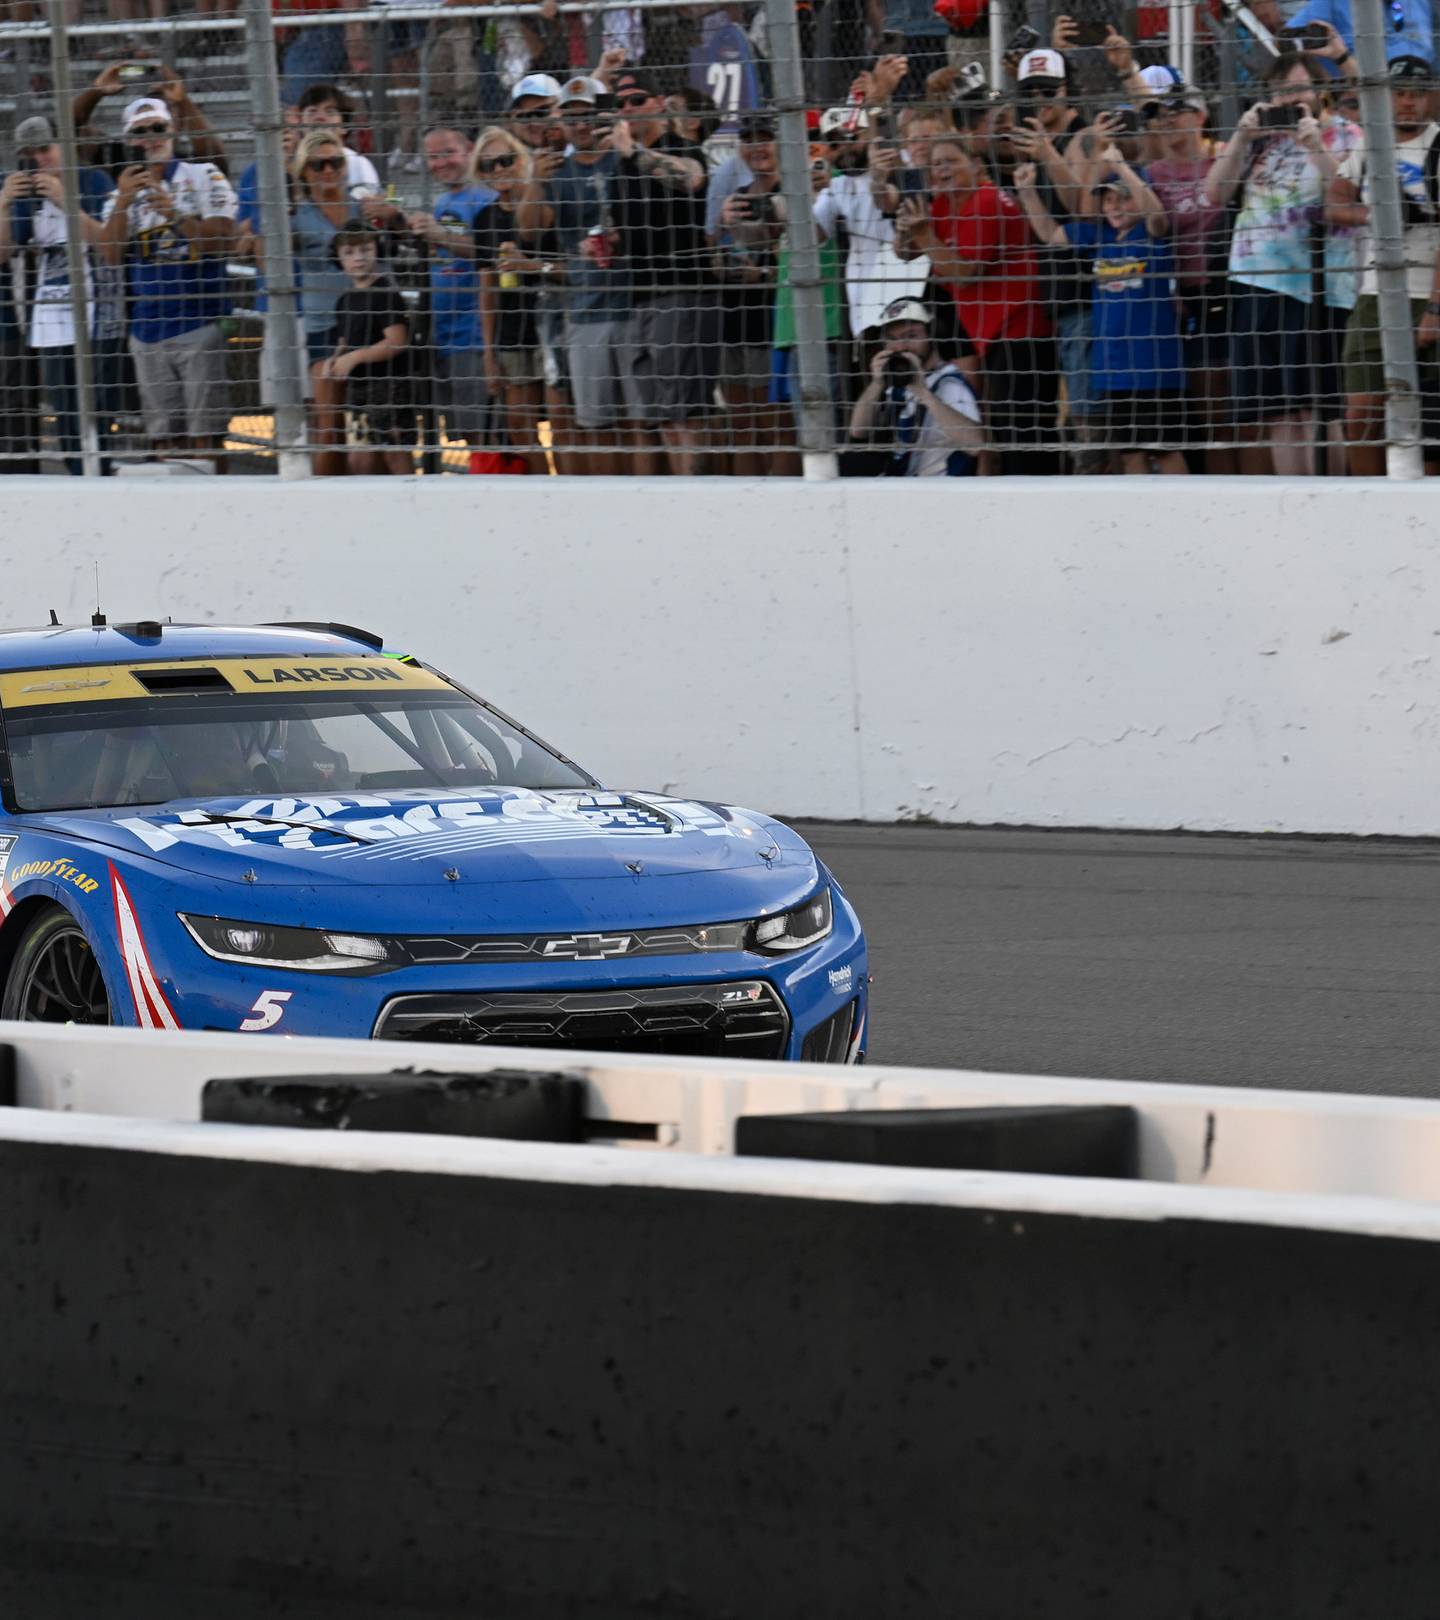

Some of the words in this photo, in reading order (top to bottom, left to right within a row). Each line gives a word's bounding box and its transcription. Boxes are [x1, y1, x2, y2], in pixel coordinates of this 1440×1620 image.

[706, 62, 742, 122] 27
[243, 667, 404, 684] LARSON
[11, 857, 100, 894] GOODYEAR
[239, 990, 293, 1031] 5
